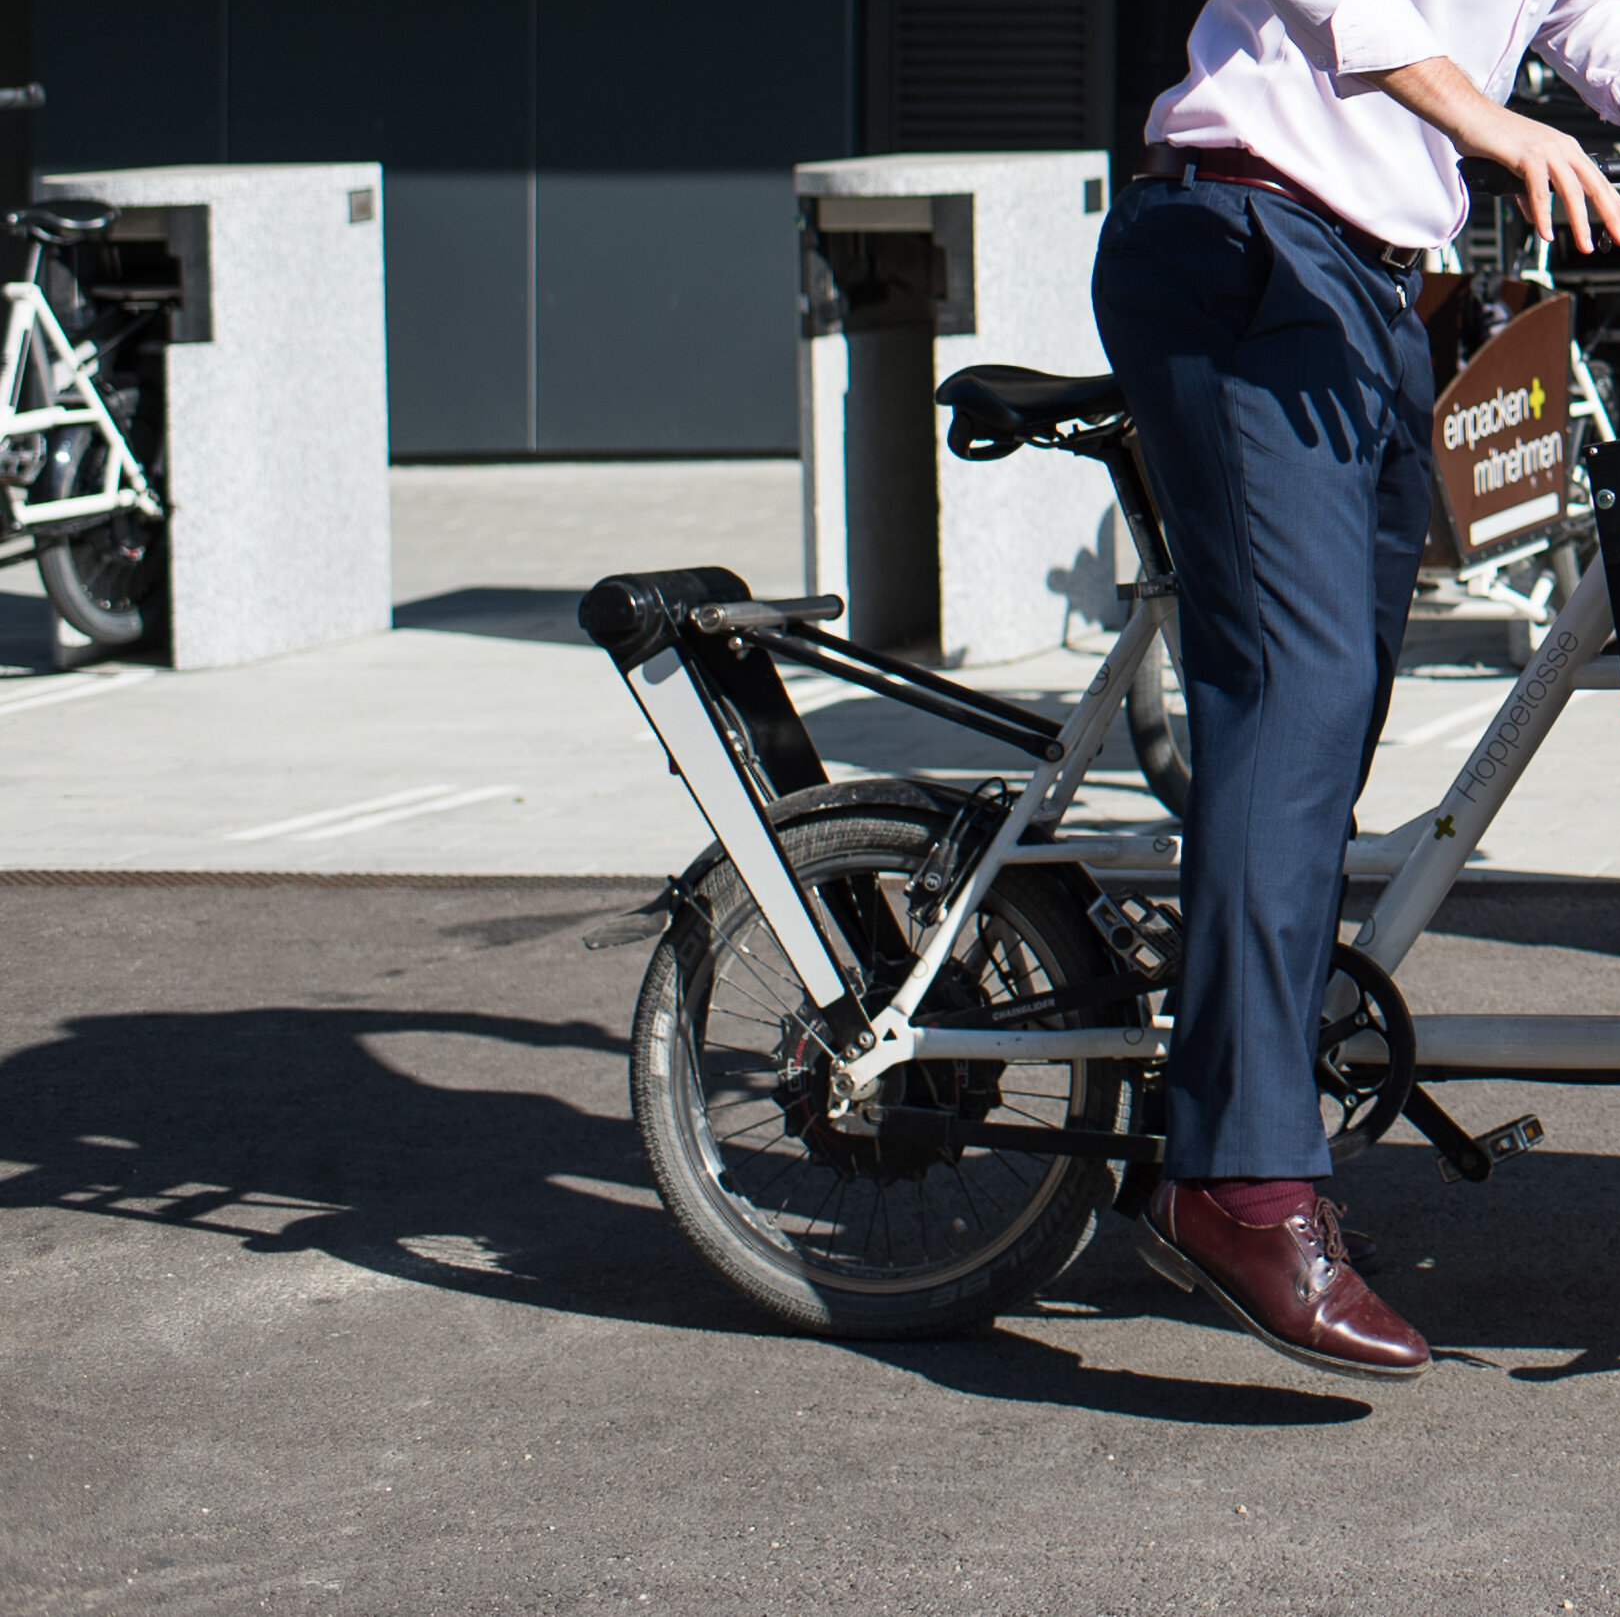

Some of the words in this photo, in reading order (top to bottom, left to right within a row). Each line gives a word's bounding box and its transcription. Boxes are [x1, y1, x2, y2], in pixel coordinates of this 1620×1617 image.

[1443, 386, 1529, 450] einpacken
[1473, 431, 1563, 497] mitnehmen
[1456, 631, 1578, 803] Hoppetosse
